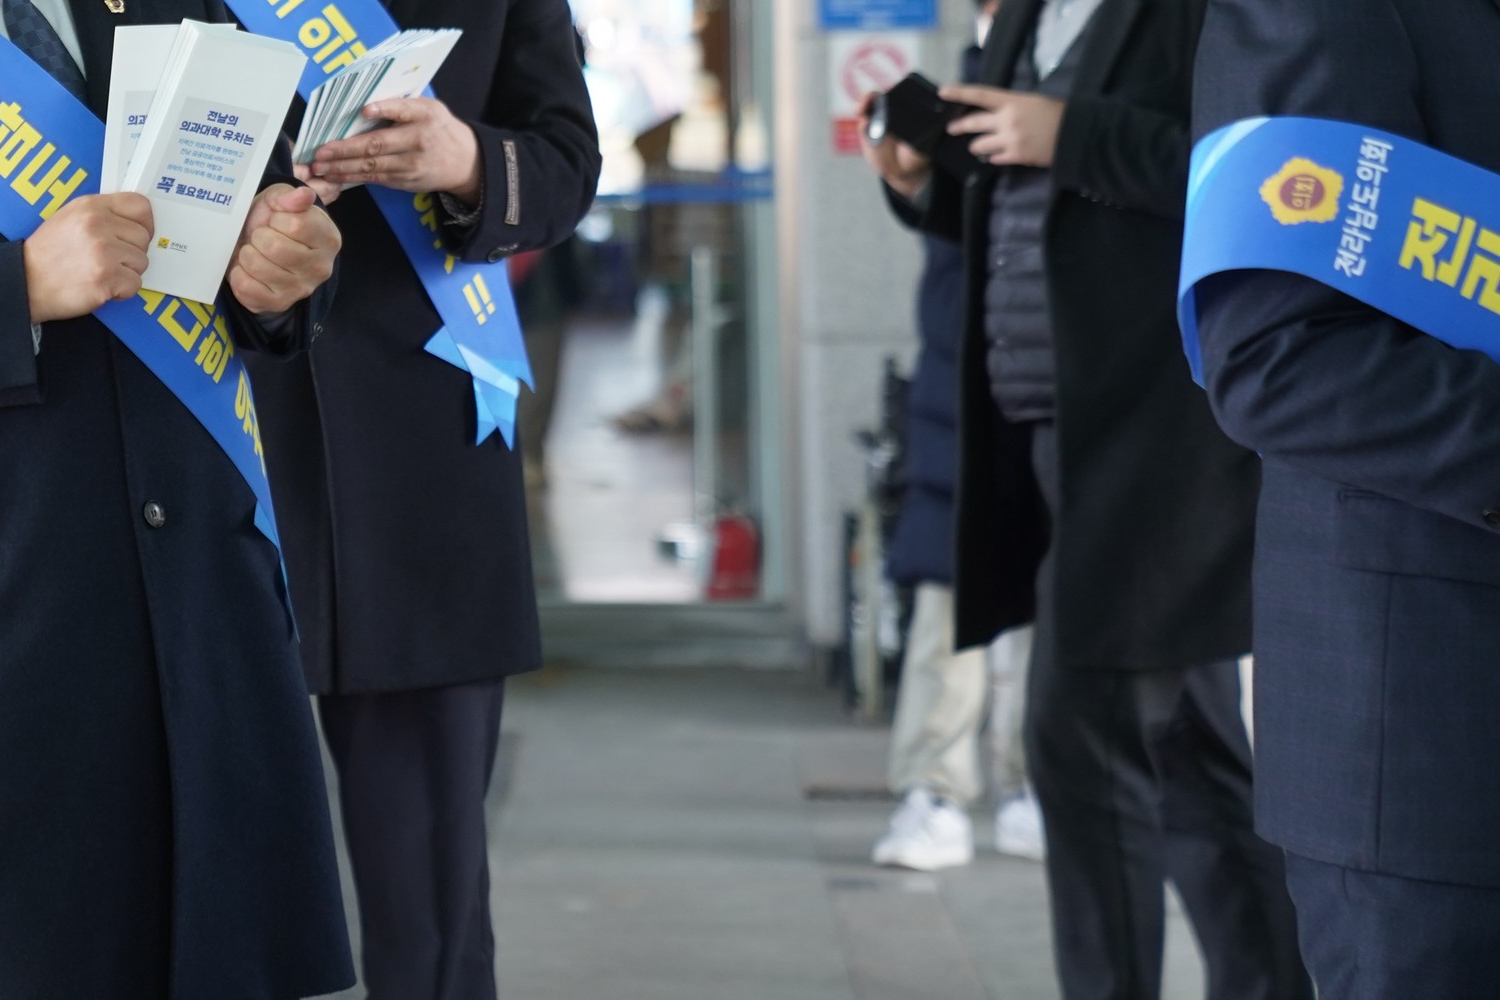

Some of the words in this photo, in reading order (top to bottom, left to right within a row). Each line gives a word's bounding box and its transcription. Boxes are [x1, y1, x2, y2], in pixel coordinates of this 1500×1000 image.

[179, 120, 222, 138] 의과대학
[222, 129, 255, 146] 유치는
[207, 110, 239, 127] 전남의
[156, 176, 175, 194] 꼭
[175, 183, 233, 206] 필요합니다!
[1290, 175, 1318, 211] 의회
[1334, 135, 1394, 278] 전라남도의회
